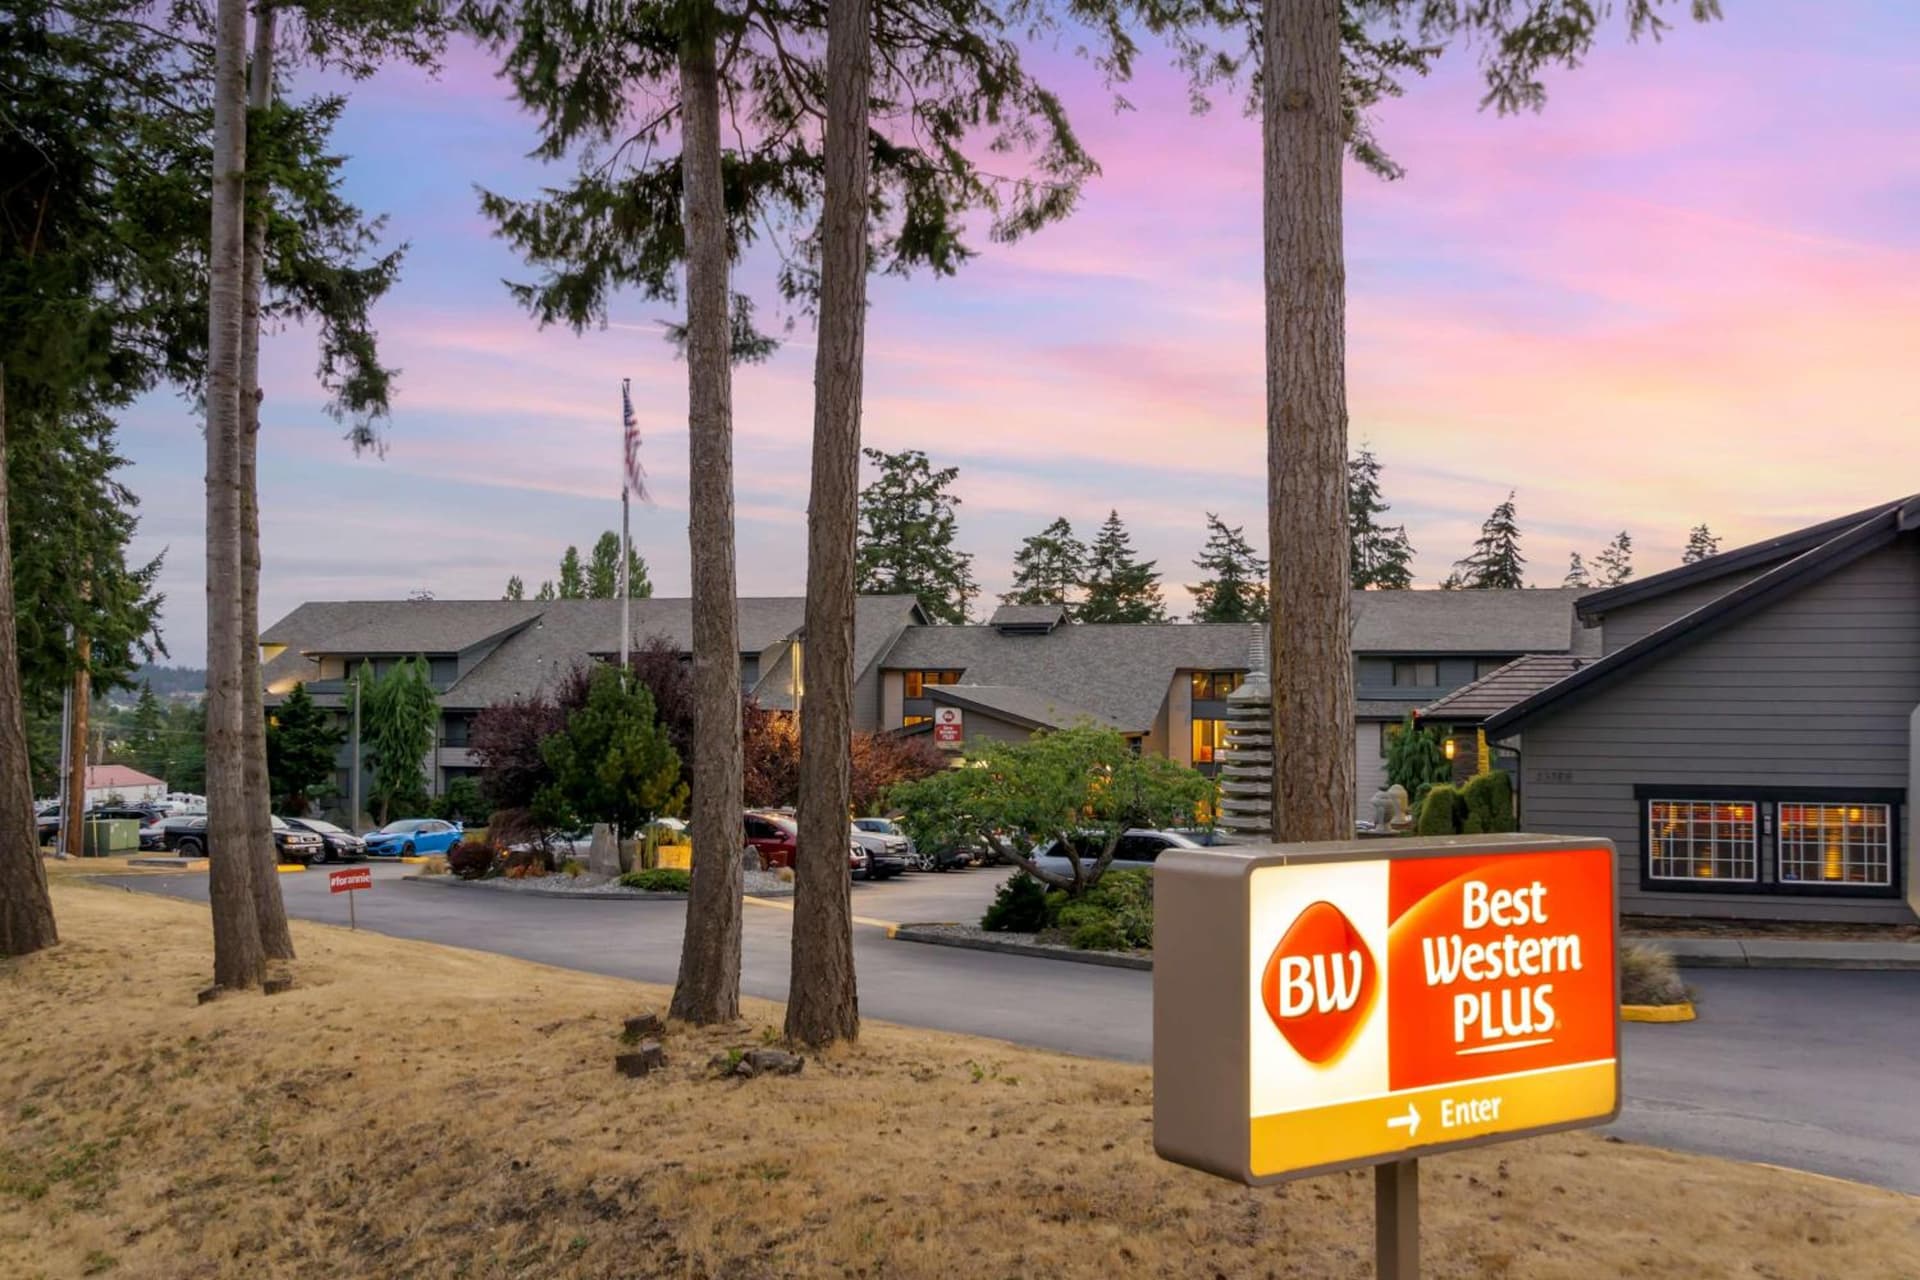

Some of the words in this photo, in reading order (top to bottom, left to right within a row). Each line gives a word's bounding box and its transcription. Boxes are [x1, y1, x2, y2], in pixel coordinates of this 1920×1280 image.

[1463, 880, 1548, 929] Best
[1279, 951, 1363, 1018] BW
[1422, 933, 1583, 986] Western
[1454, 984, 1555, 1042] PLUS
[1440, 1097, 1502, 1128] Enter
